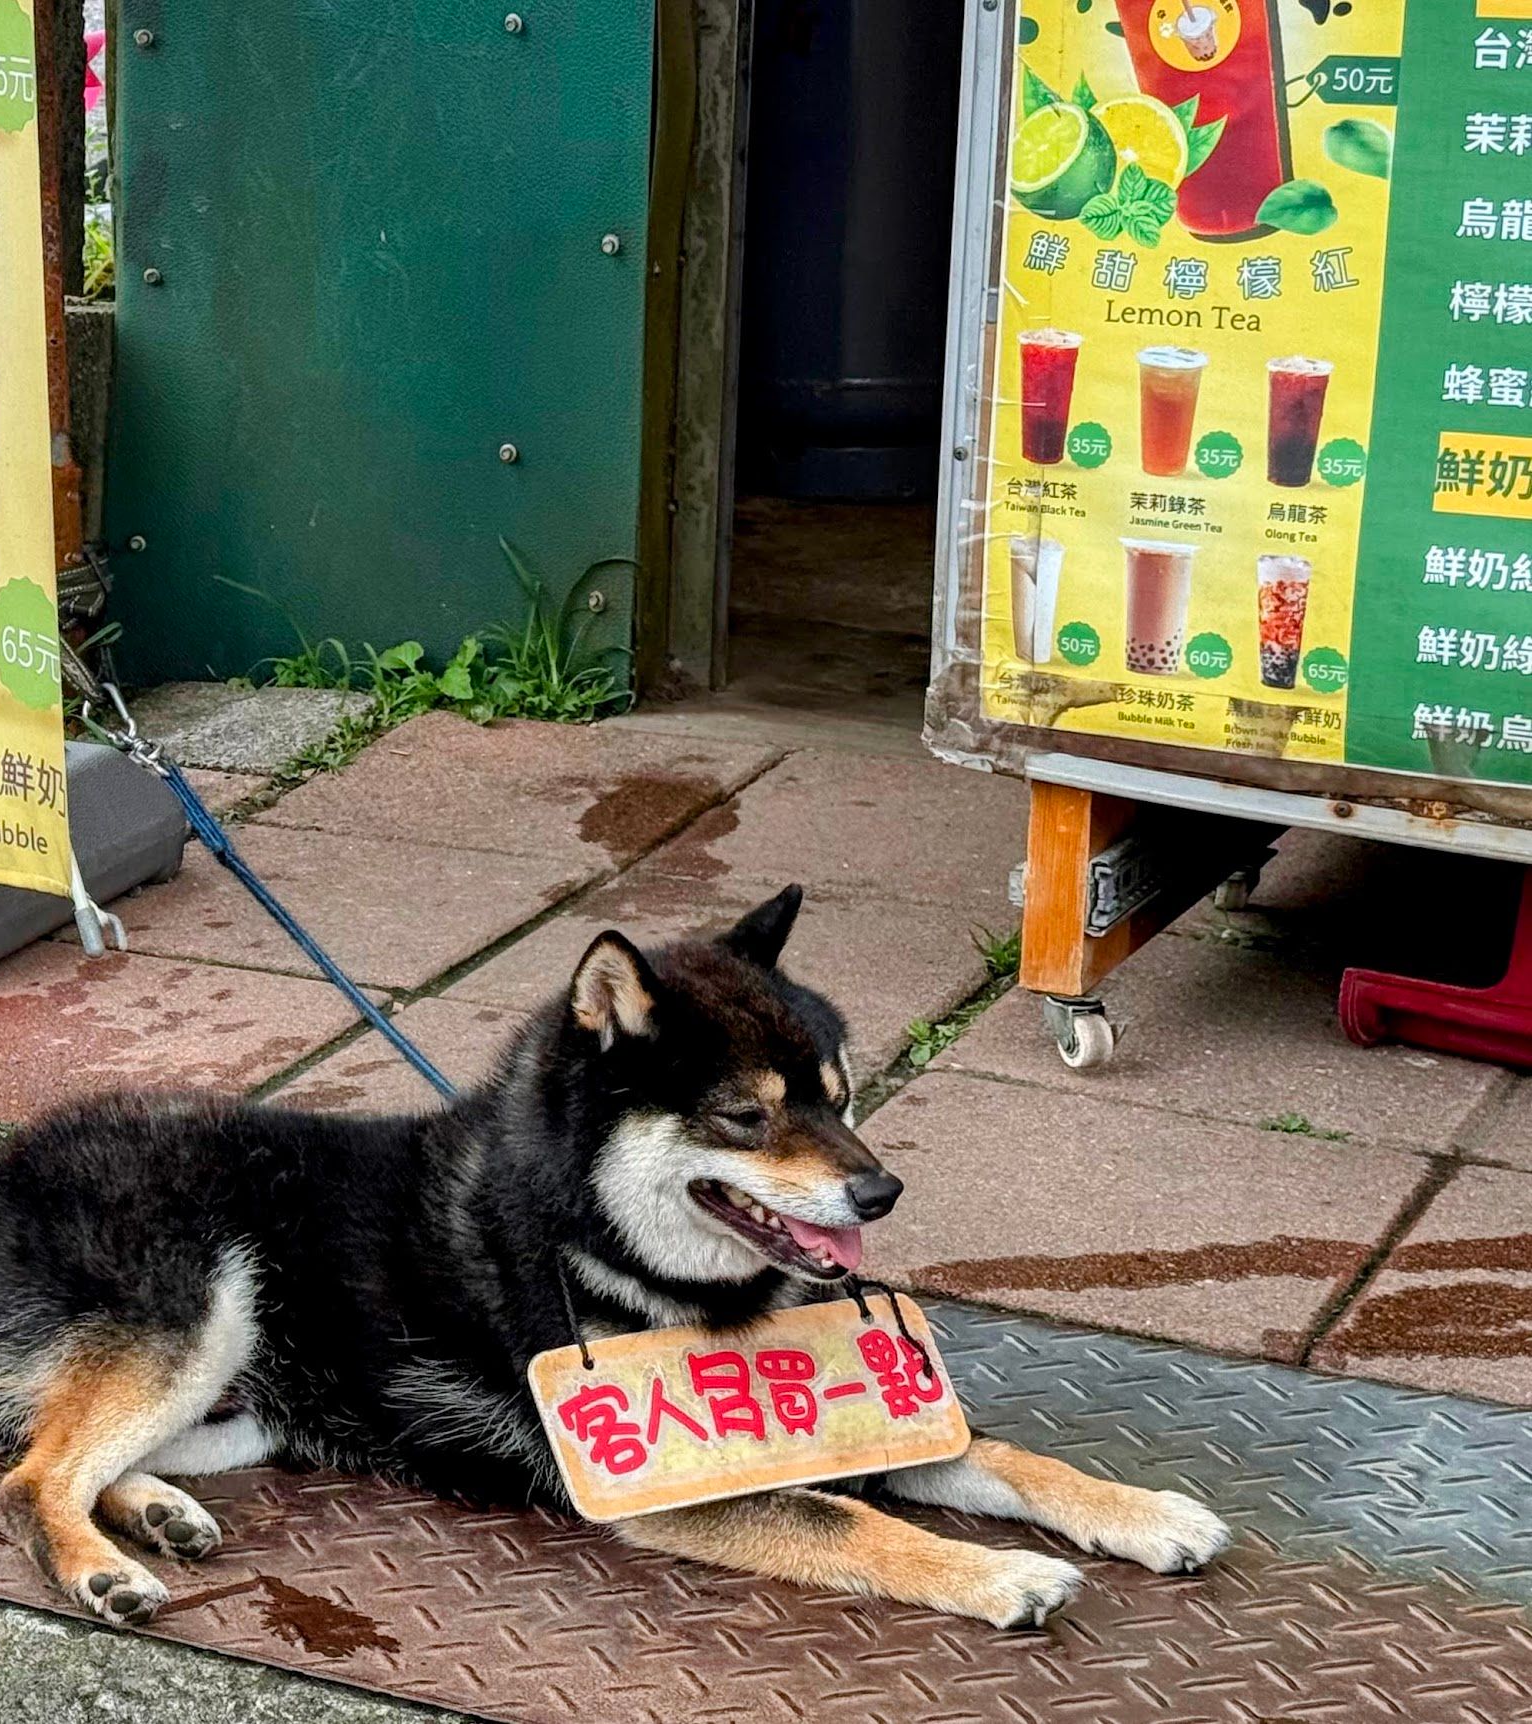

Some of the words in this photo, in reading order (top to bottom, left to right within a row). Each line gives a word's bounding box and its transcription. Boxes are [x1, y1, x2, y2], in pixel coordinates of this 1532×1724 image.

[1332, 66, 1394, 95] 50元
[1023, 231, 1359, 300] 鮮甜檸檬紅
[1449, 280, 1532, 325] 檸檬
[1104, 300, 1203, 328] Lemon
[1211, 306, 1262, 332] Tea
[1441, 363, 1532, 408] 蜂蜜
[1071, 437, 1108, 456] 35元
[1199, 447, 1239, 468] 35元
[1321, 457, 1363, 480] 35元
[1434, 447, 1532, 500] 鮮奶
[1004, 501, 1039, 513] Taiwan
[1040, 504, 1067, 516] Black
[1068, 507, 1086, 517] Tea
[1266, 502, 1328, 525] 烏龍茶
[1129, 515, 1169, 528] Jasmine
[1171, 520, 1202, 531] Green
[1203, 522, 1223, 533] Tea
[1264, 528, 1297, 543] Olong
[1298, 531, 1318, 542] Tea
[2, 625, 61, 684] 65元
[1061, 636, 1095, 653] 50元
[1189, 651, 1229, 670] 60元
[1308, 664, 1348, 682] 65元
[1118, 687, 1195, 712] 珍珠奶茶
[1118, 711, 1153, 724] Bubble
[1154, 716, 1175, 726] Milk
[1176, 718, 1195, 729] Tea
[1290, 732, 1326, 745] Bubble
